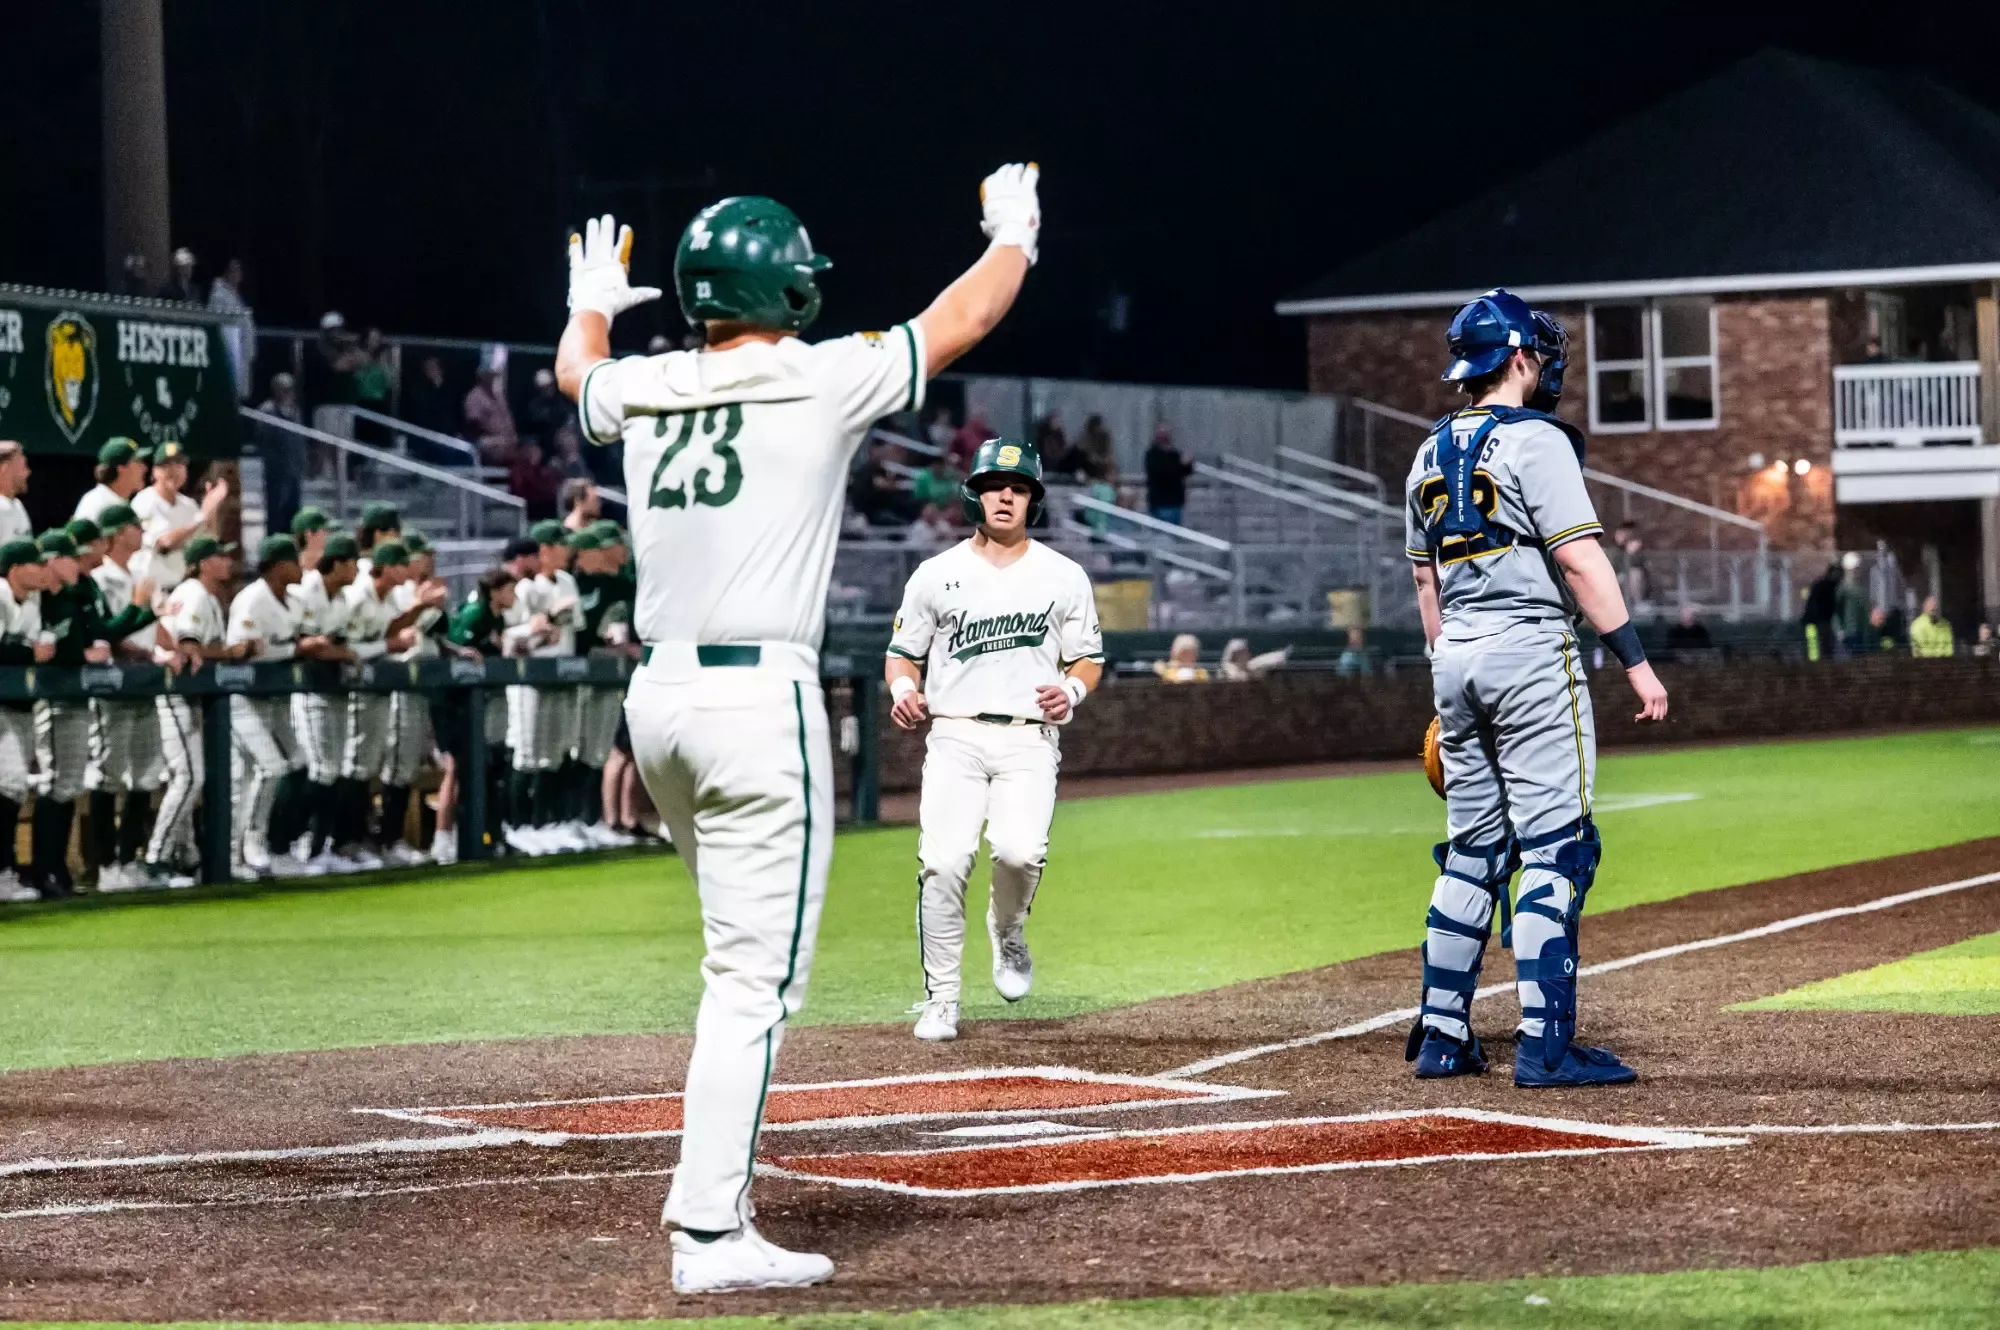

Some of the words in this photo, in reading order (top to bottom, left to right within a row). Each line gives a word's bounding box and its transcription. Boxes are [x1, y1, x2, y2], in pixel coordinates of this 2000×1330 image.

[117, 320, 210, 368] HESTER
[647, 403, 744, 511] 23
[996, 445, 1022, 467] S
[948, 600, 1055, 652] Hammond
[981, 637, 1016, 652] AMERICA
